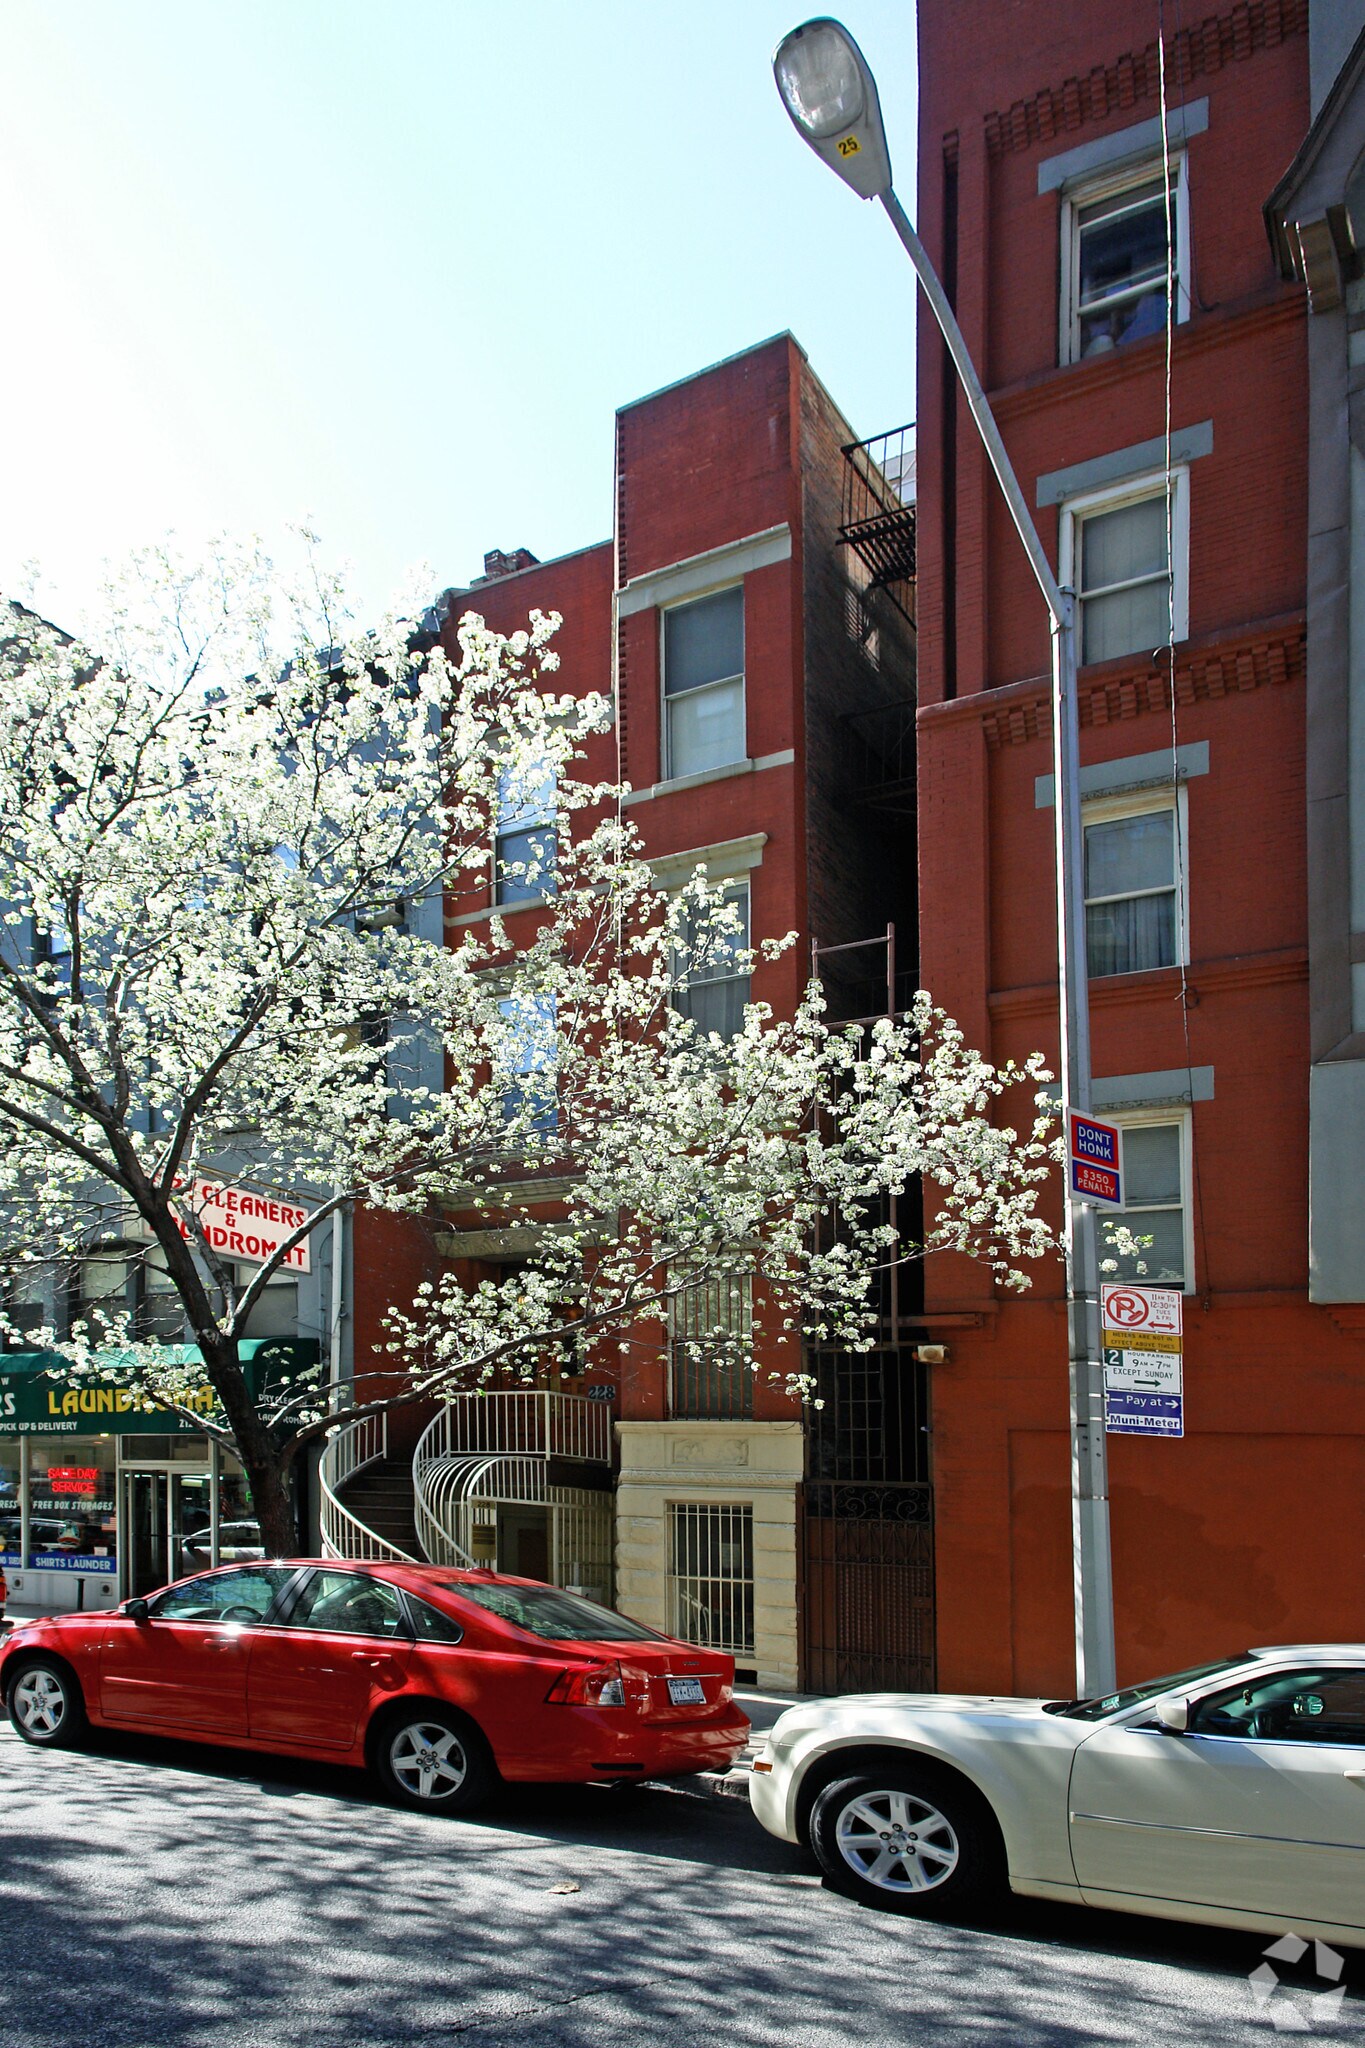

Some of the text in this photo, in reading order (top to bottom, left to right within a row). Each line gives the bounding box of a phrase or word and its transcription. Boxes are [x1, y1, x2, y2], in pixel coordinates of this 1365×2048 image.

[838, 136, 858, 156] 25
[1079, 1140, 1111, 1160] HONK
[1077, 1177, 1115, 1196] PENALTY
[201, 1185, 305, 1228] CLEANERS
[225, 1213, 236, 1228] &
[1108, 1349, 1120, 1365] 2
[1113, 1368, 1173, 1379] EXCEPT SUNDAY
[589, 1385, 616, 1400] 228
[1126, 1395, 1162, 1407] Pay at
[19, 1423, 30, 1431] UP
[38, 1421, 78, 1431] DELIVERY
[1110, 1414, 1179, 1428] Muni-Meter
[48, 1467, 98, 1479] SAME DAY
[52, 1481, 96, 1493] SERVICE
[33, 1501, 52, 1510] FREE
[54, 1501, 70, 1509] BOX
[71, 1501, 114, 1511] STORAGES
[35, 1557, 111, 1570] SHIRTS LAUNDER
